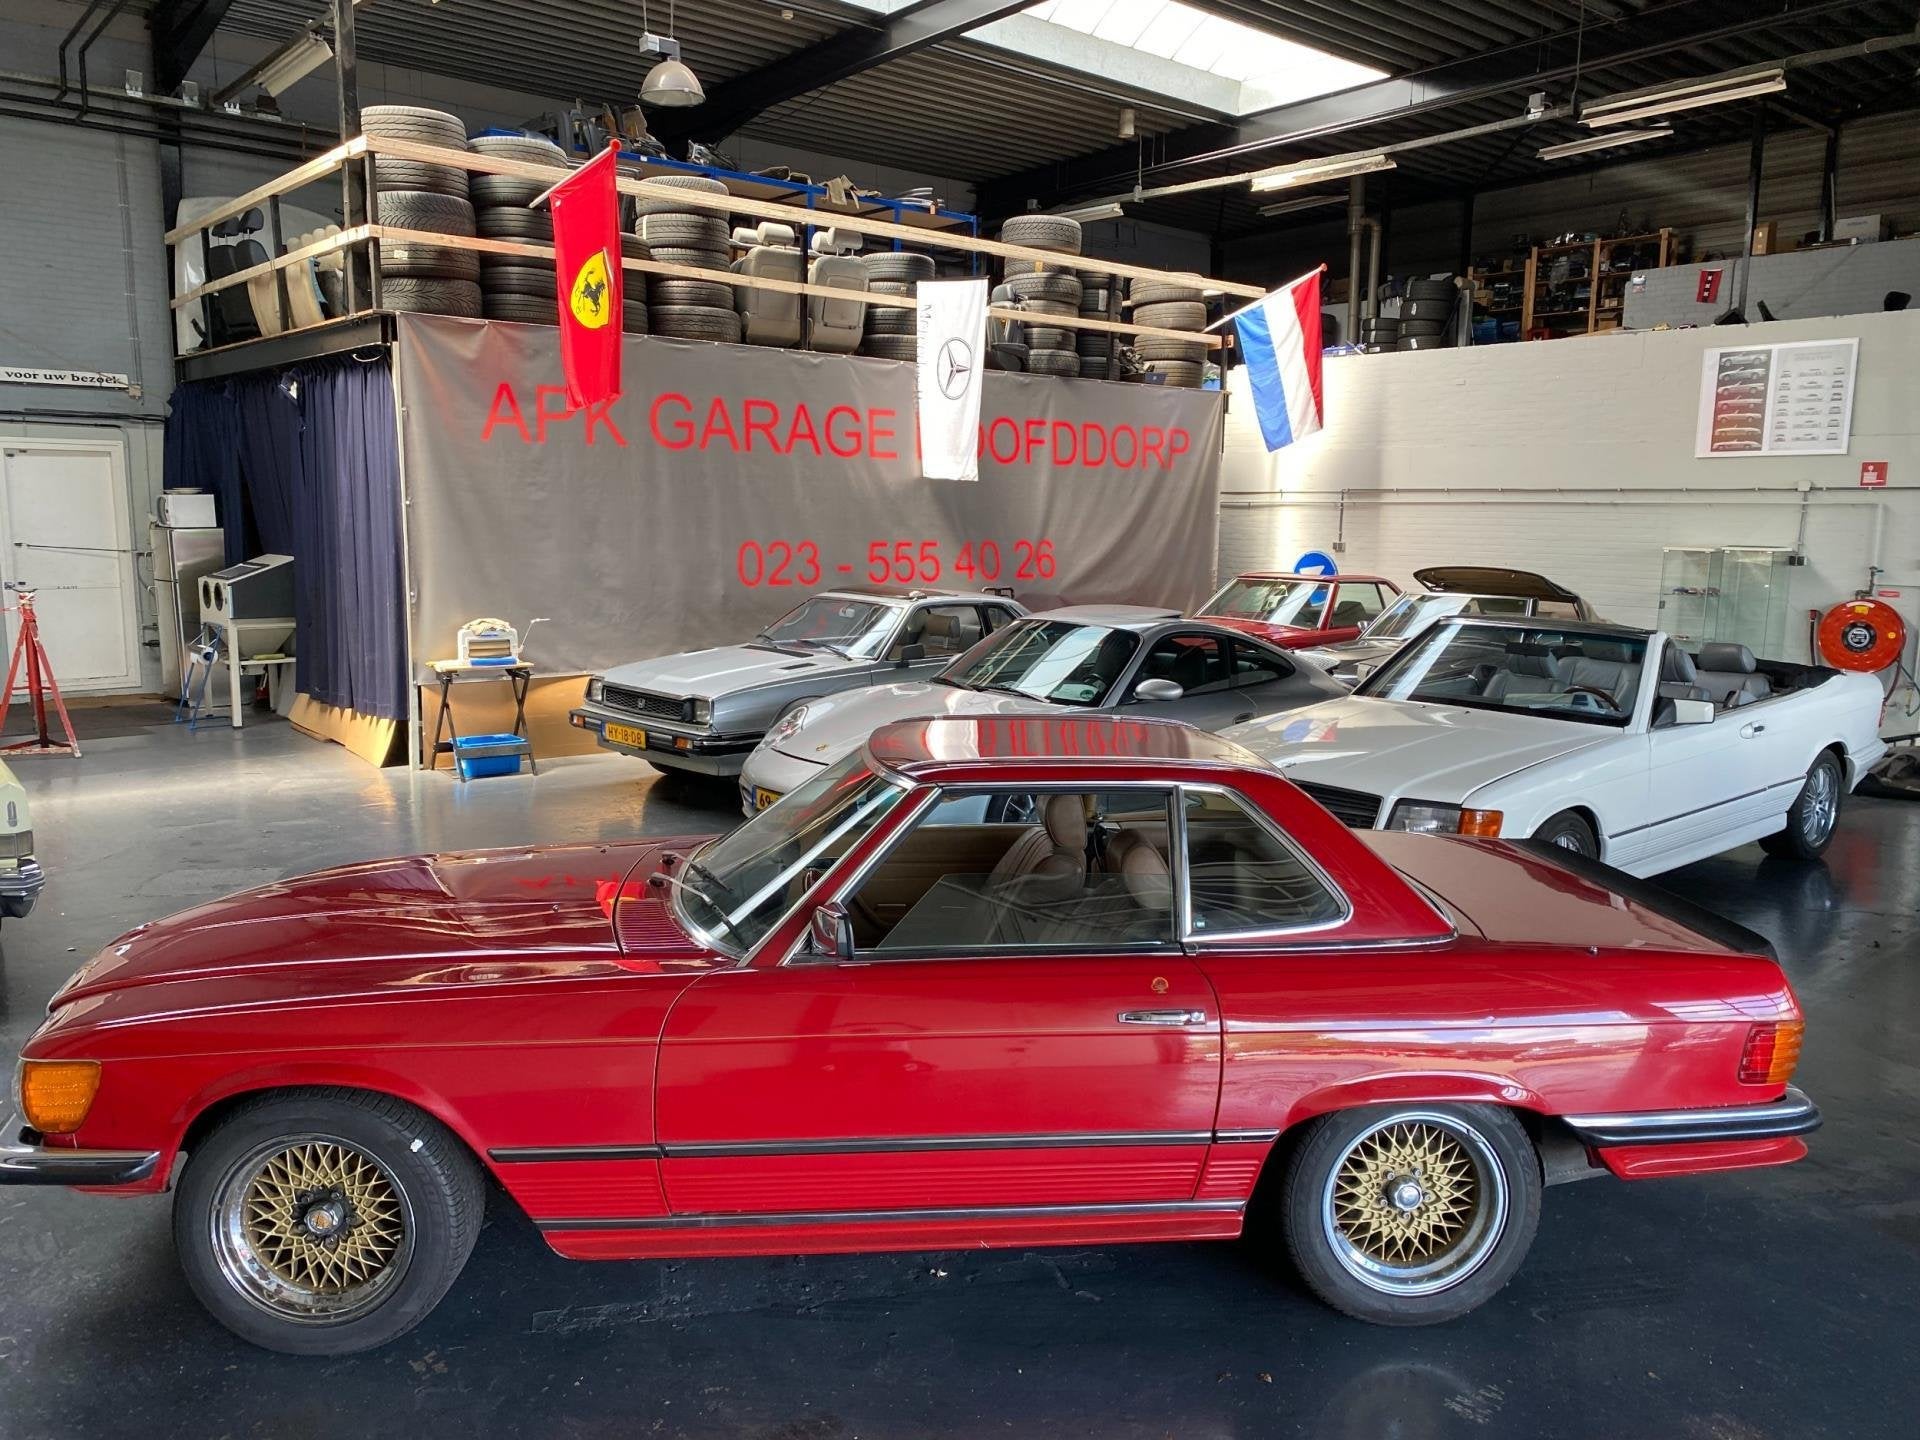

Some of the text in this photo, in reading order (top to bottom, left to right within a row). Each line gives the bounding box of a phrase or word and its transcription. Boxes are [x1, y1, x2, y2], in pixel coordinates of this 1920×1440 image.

[5, 371, 120, 384] voor uw bezoek
[480, 383, 1191, 471] APK GARAGE OFDDORP
[736, 540, 821, 588] 023
[868, 541, 941, 583] 555
[955, 540, 1001, 580] 40
[1014, 540, 1056, 579] 26
